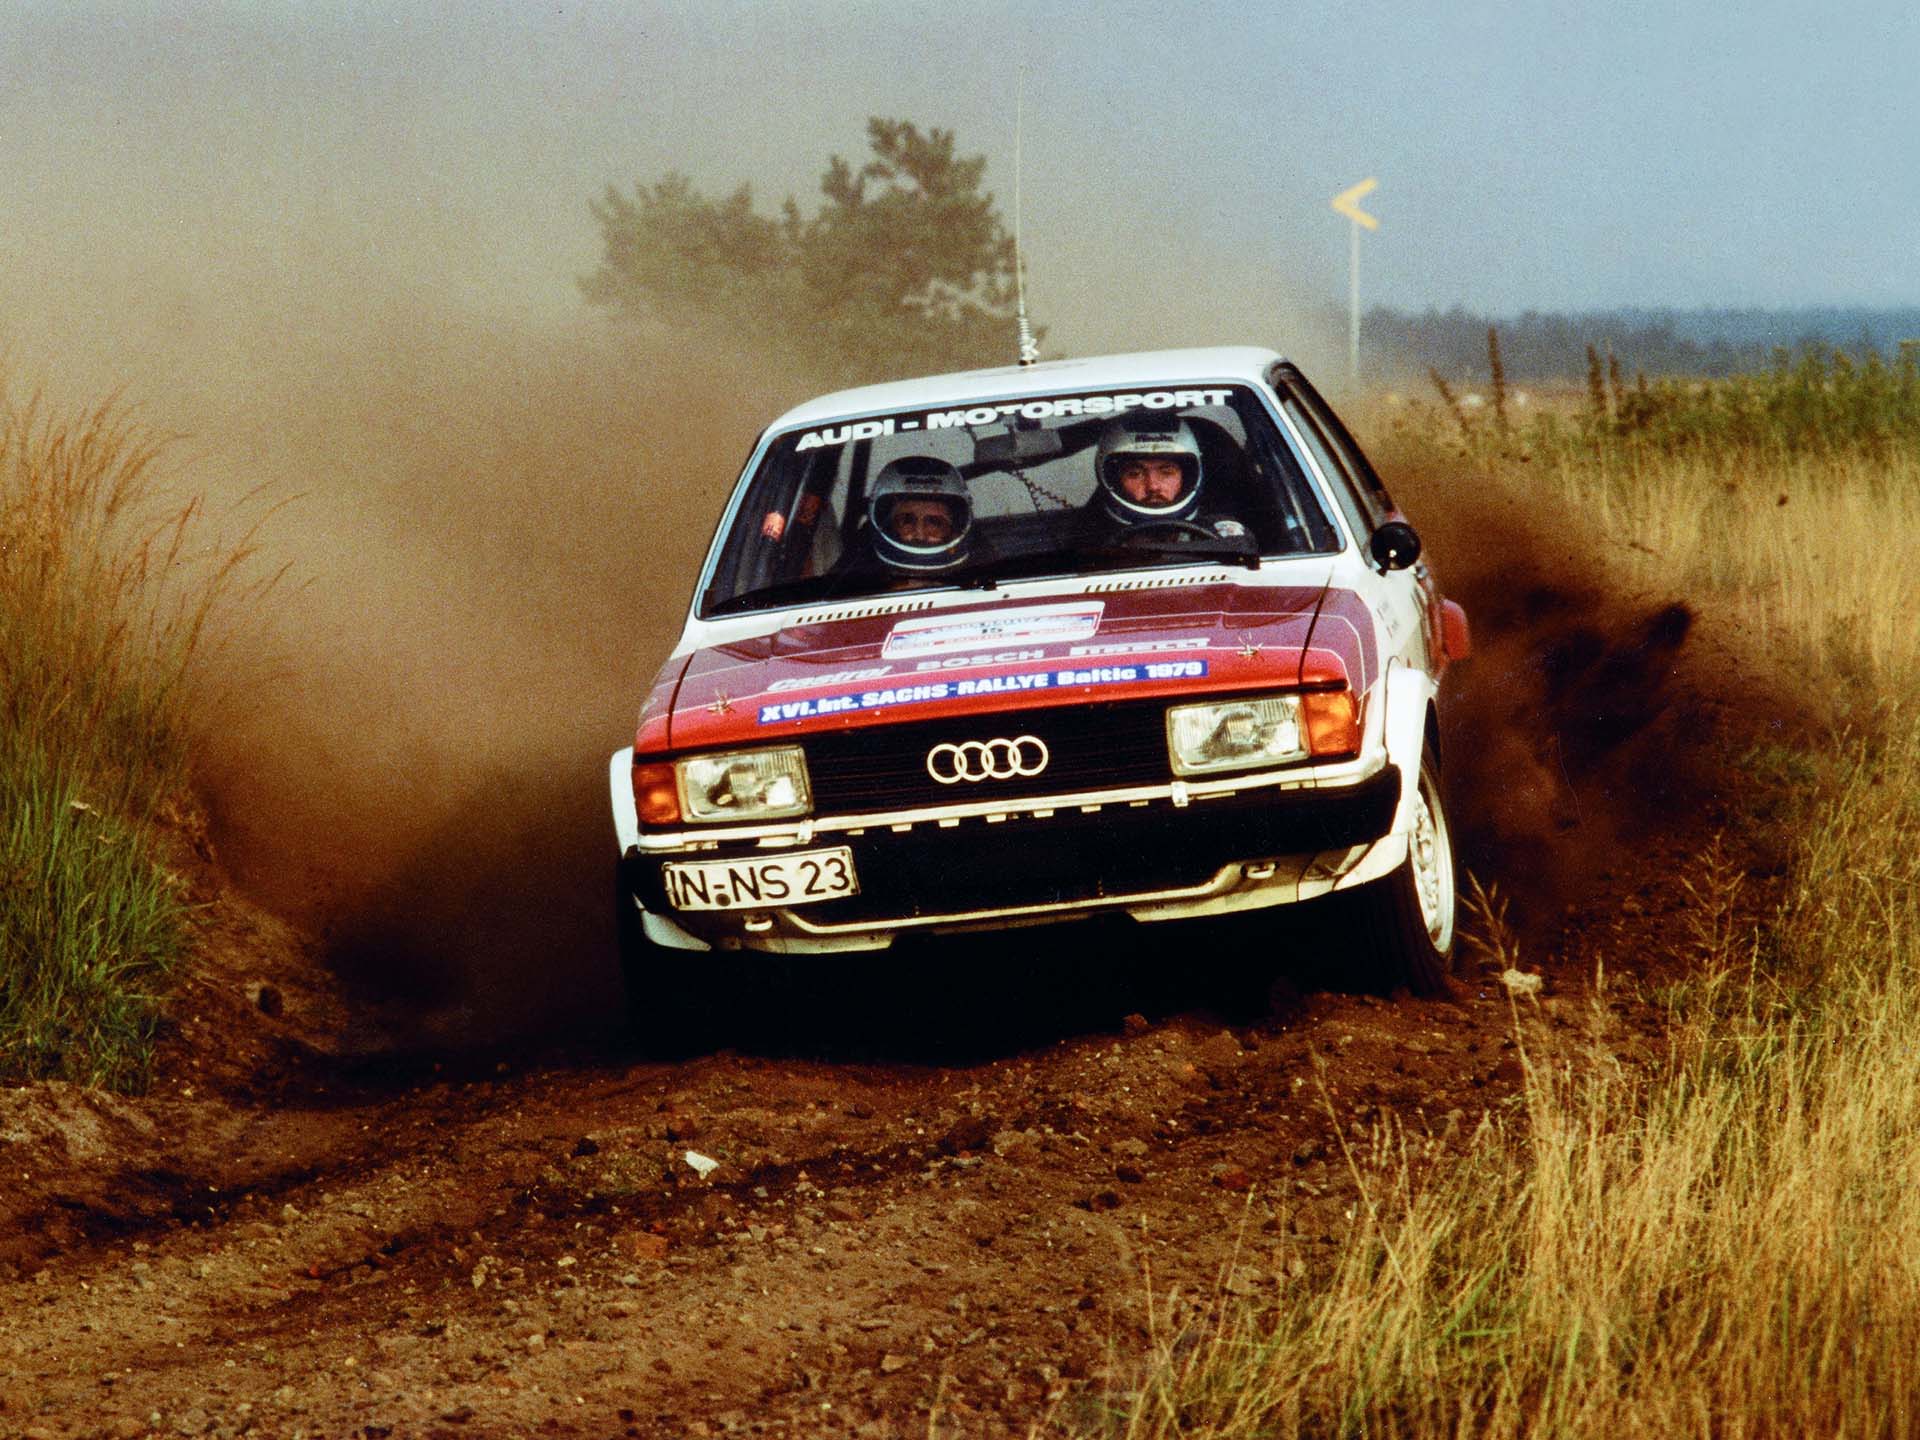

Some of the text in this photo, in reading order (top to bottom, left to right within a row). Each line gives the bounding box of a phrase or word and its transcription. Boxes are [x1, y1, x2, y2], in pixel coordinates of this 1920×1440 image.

[916, 650, 1045, 671] BOSCH
[1057, 667, 1137, 686] Baltic
[1145, 661, 1203, 678] 1979
[800, 857, 850, 896] 23
